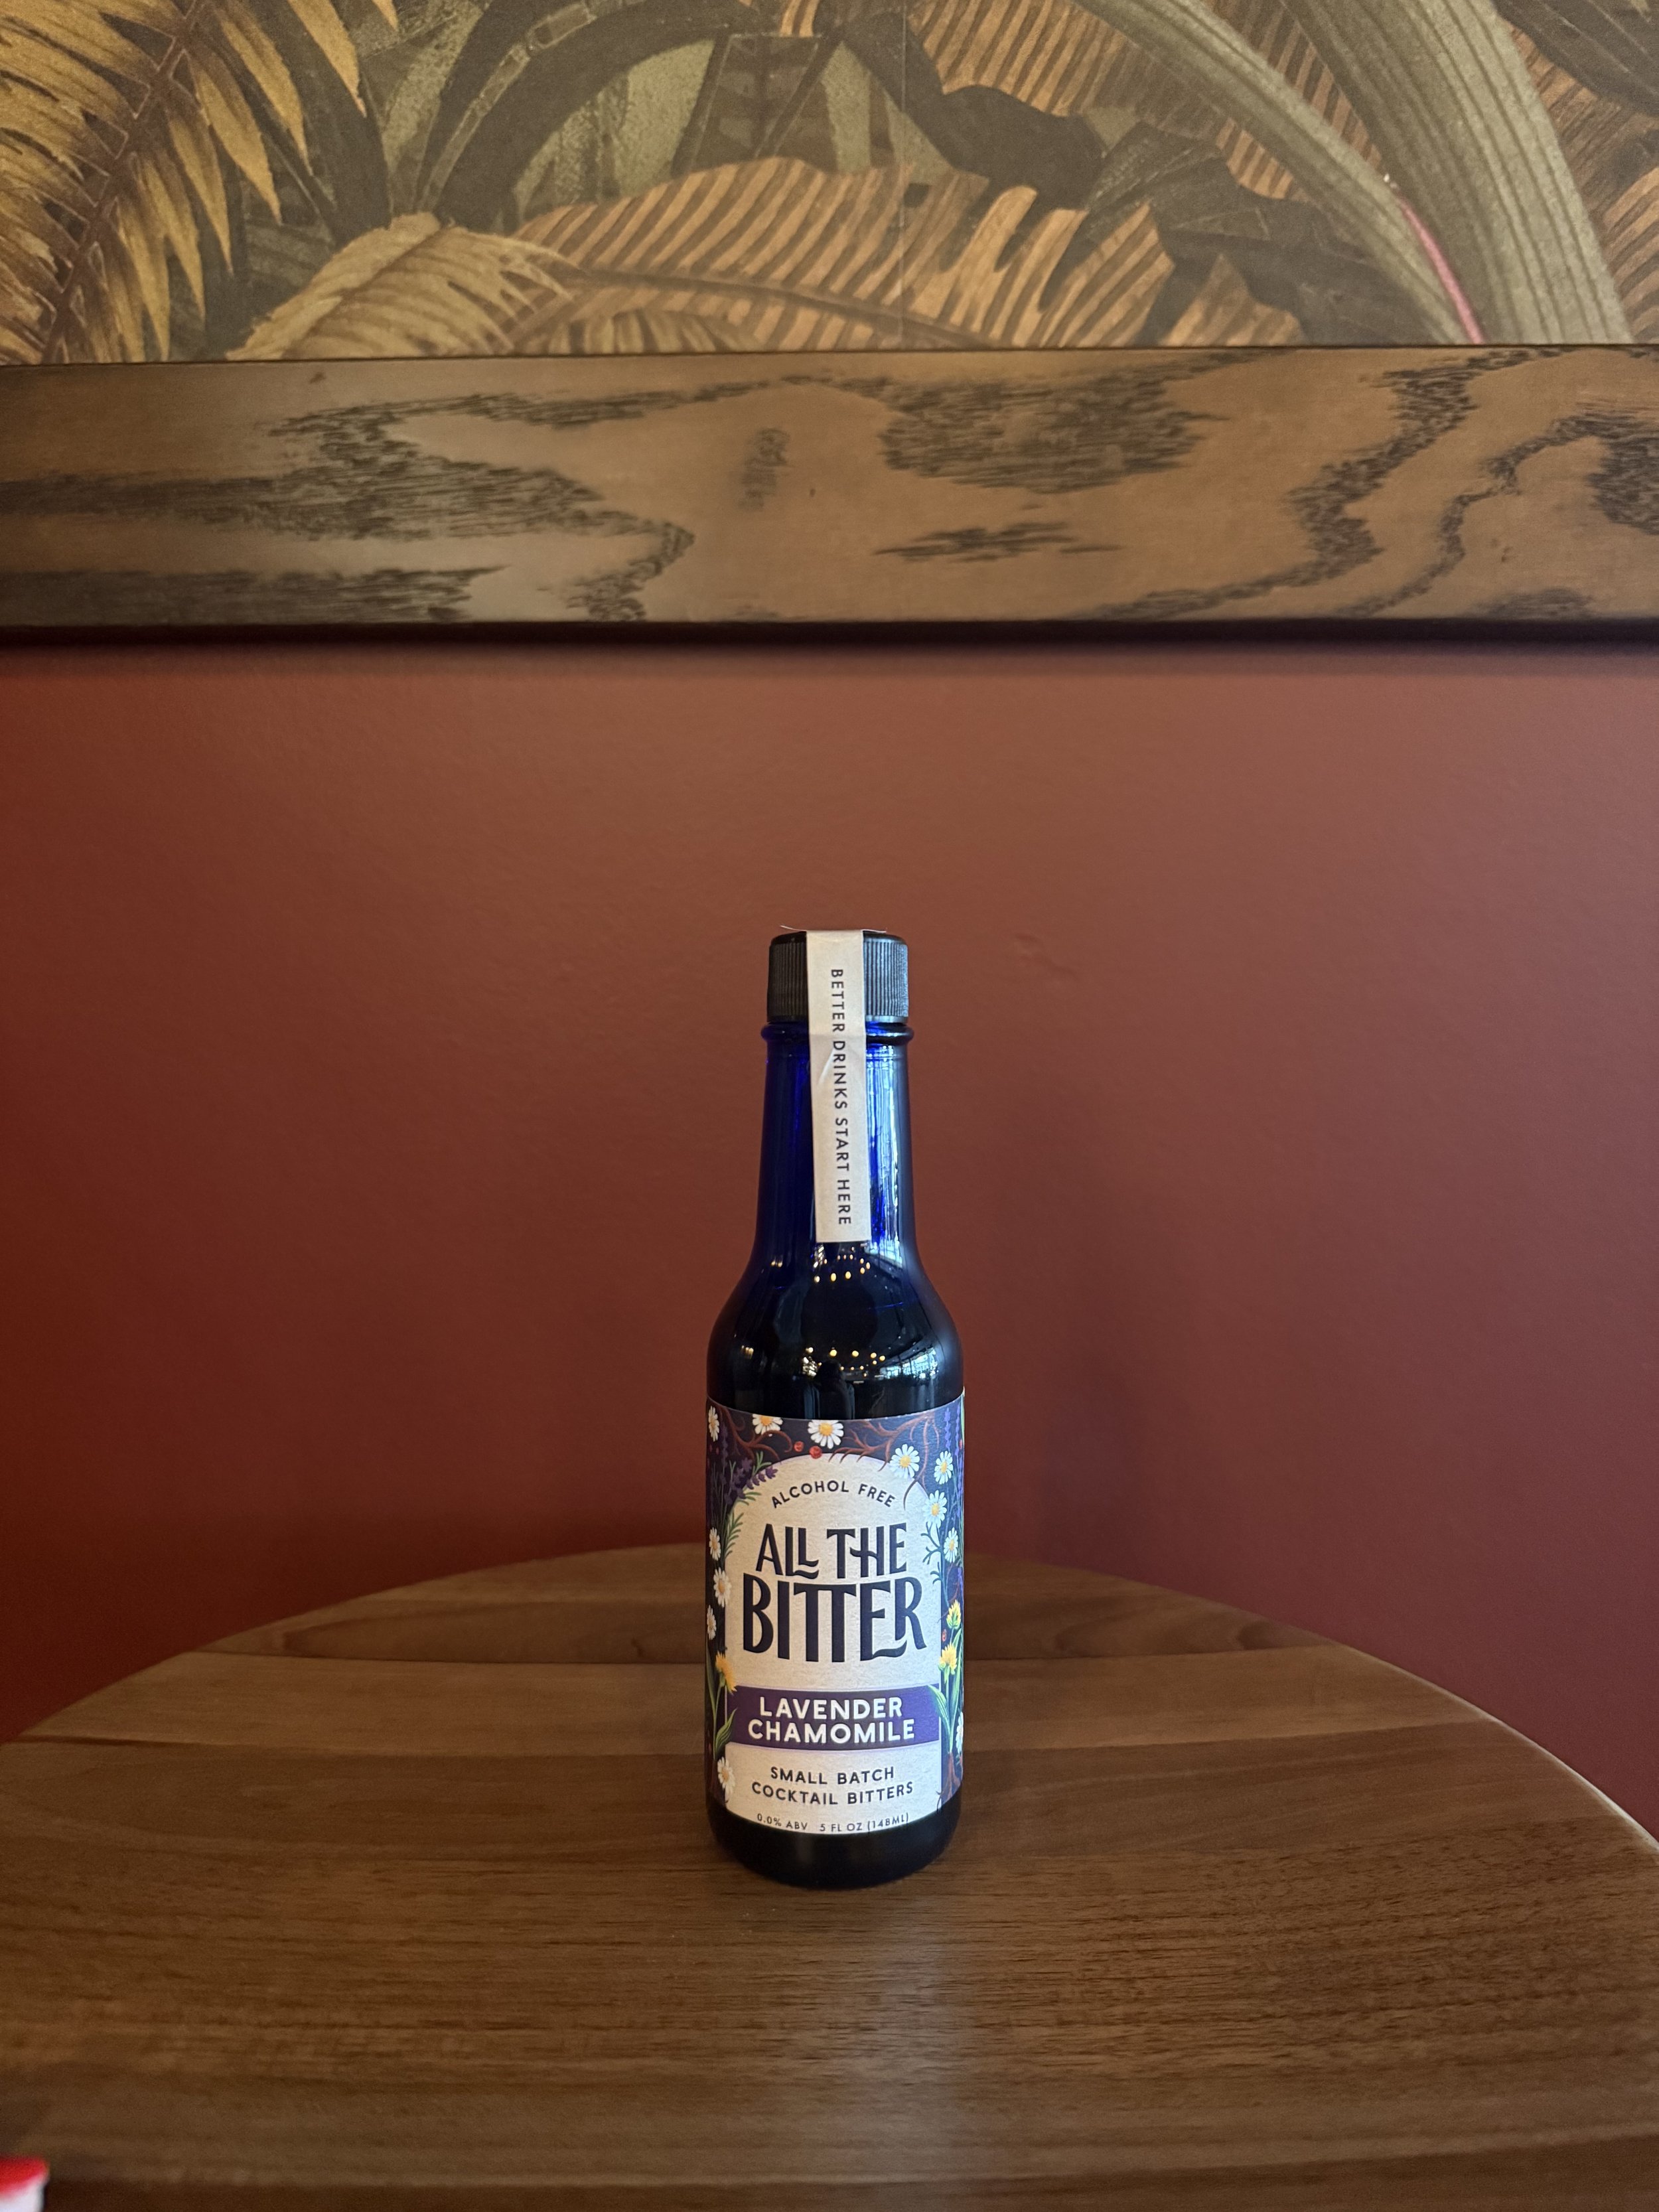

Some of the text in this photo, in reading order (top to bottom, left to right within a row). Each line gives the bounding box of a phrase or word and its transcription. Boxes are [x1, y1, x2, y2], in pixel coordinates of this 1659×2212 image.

[831, 968, 851, 1225] BETTER DRINKS START HERE
[771, 1479, 896, 1509] ALCOHOL FREE
[756, 1522, 906, 1579] ALL THE
[743, 1572, 927, 1662] BITTER
[759, 1696, 902, 1720] LAVENDER
[748, 1719, 915, 1743] CHAMOMILE
[770, 1766, 895, 1785] SMALL BATCH
[752, 1781, 914, 1805] COCKTAIL BITTERS
[757, 1812, 782, 1827] 0.0%
[786, 1820, 808, 1831] ABV
[820, 1823, 826, 1832] 5
[831, 1823, 843, 1832] FL
[846, 1822, 863, 1831] OZ
